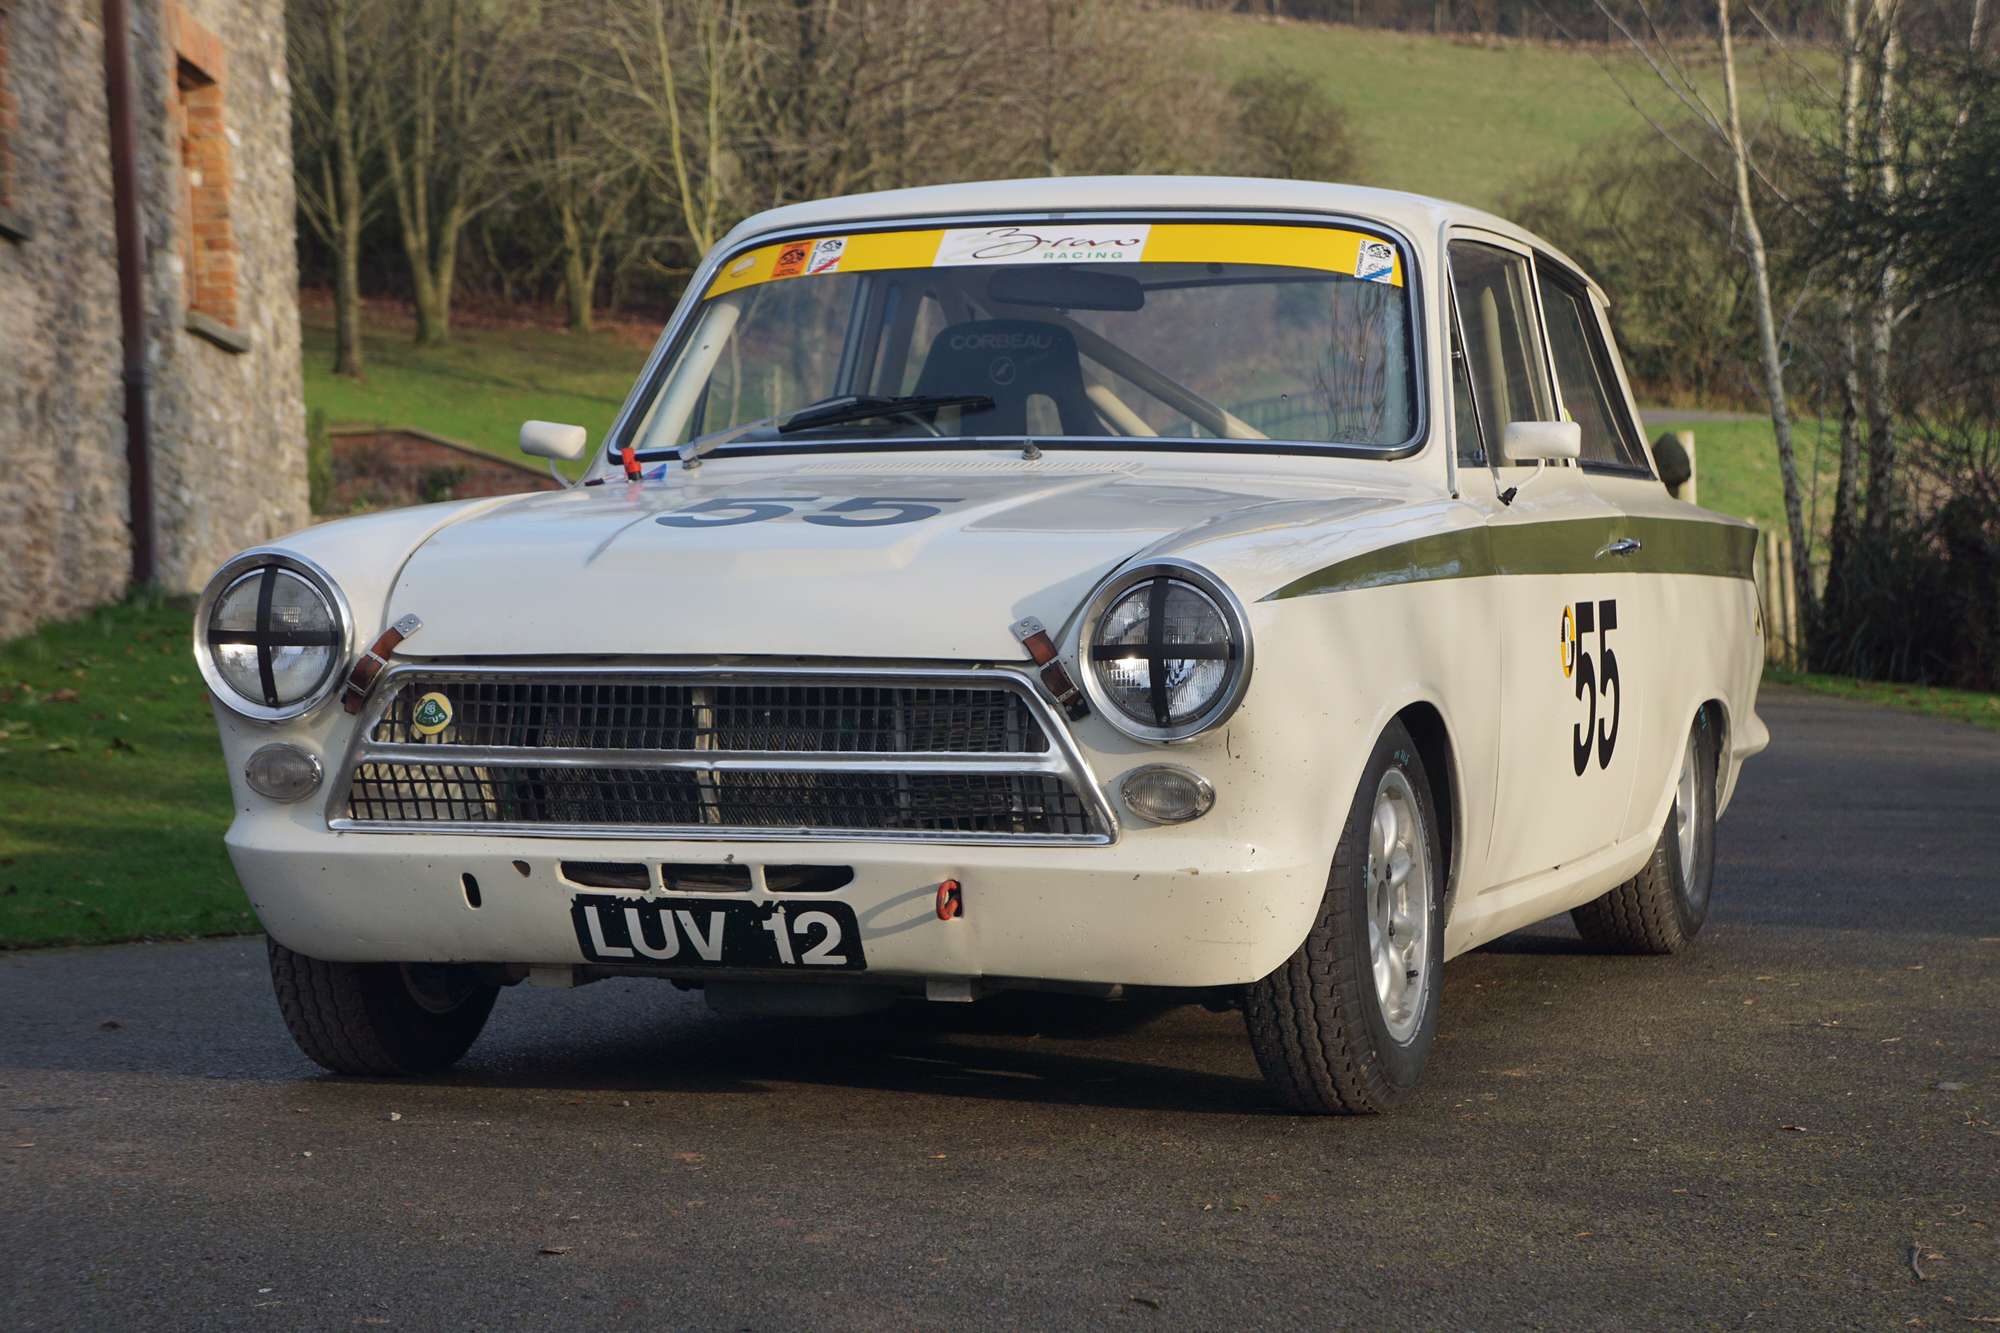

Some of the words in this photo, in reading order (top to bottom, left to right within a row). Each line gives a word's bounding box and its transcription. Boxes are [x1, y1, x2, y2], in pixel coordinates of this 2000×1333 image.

[1042, 251, 1124, 259] RACING
[950, 334, 1053, 350] CORBEAU
[655, 496, 967, 528] 55
[1572, 599, 1620, 777] 55
[584, 905, 726, 962] LUV
[762, 908, 848, 965] 12
